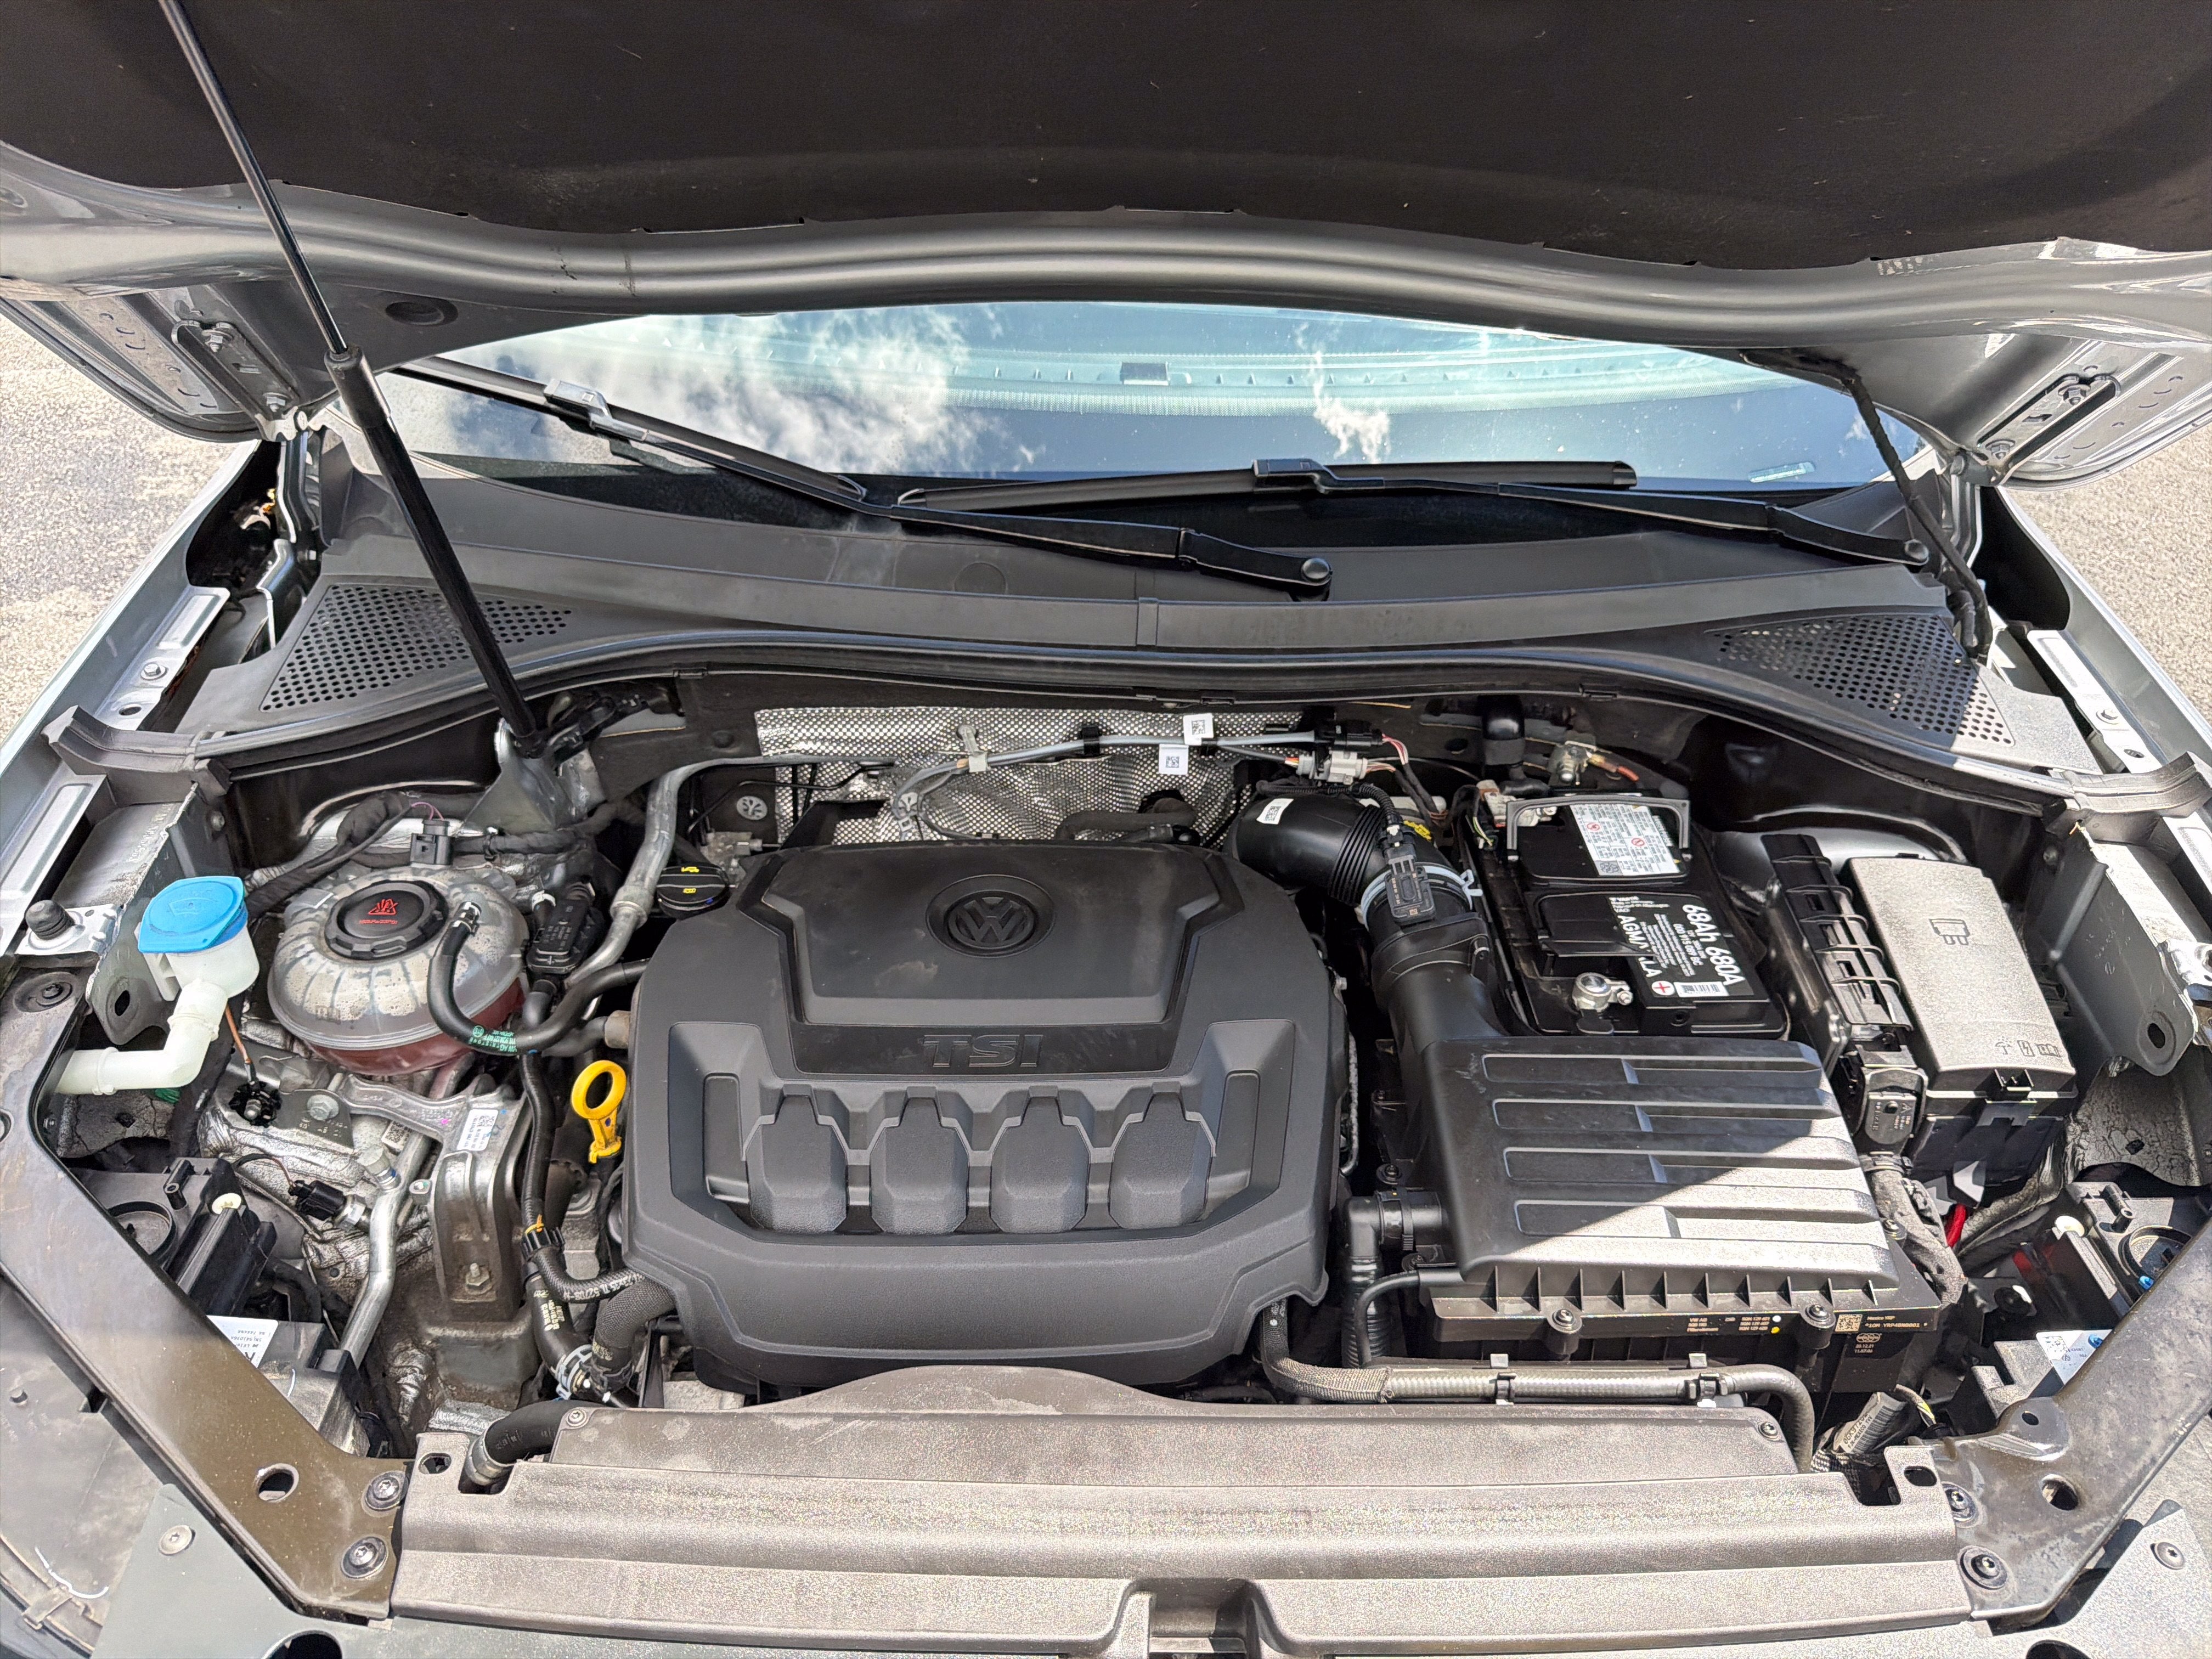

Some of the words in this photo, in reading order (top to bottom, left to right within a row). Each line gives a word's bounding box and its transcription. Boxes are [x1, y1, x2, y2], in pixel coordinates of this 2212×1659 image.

[1682, 904, 1721, 942] 68Ah
[1705, 946, 1746, 985] 680A
[923, 1034, 1043, 1068] TSI
